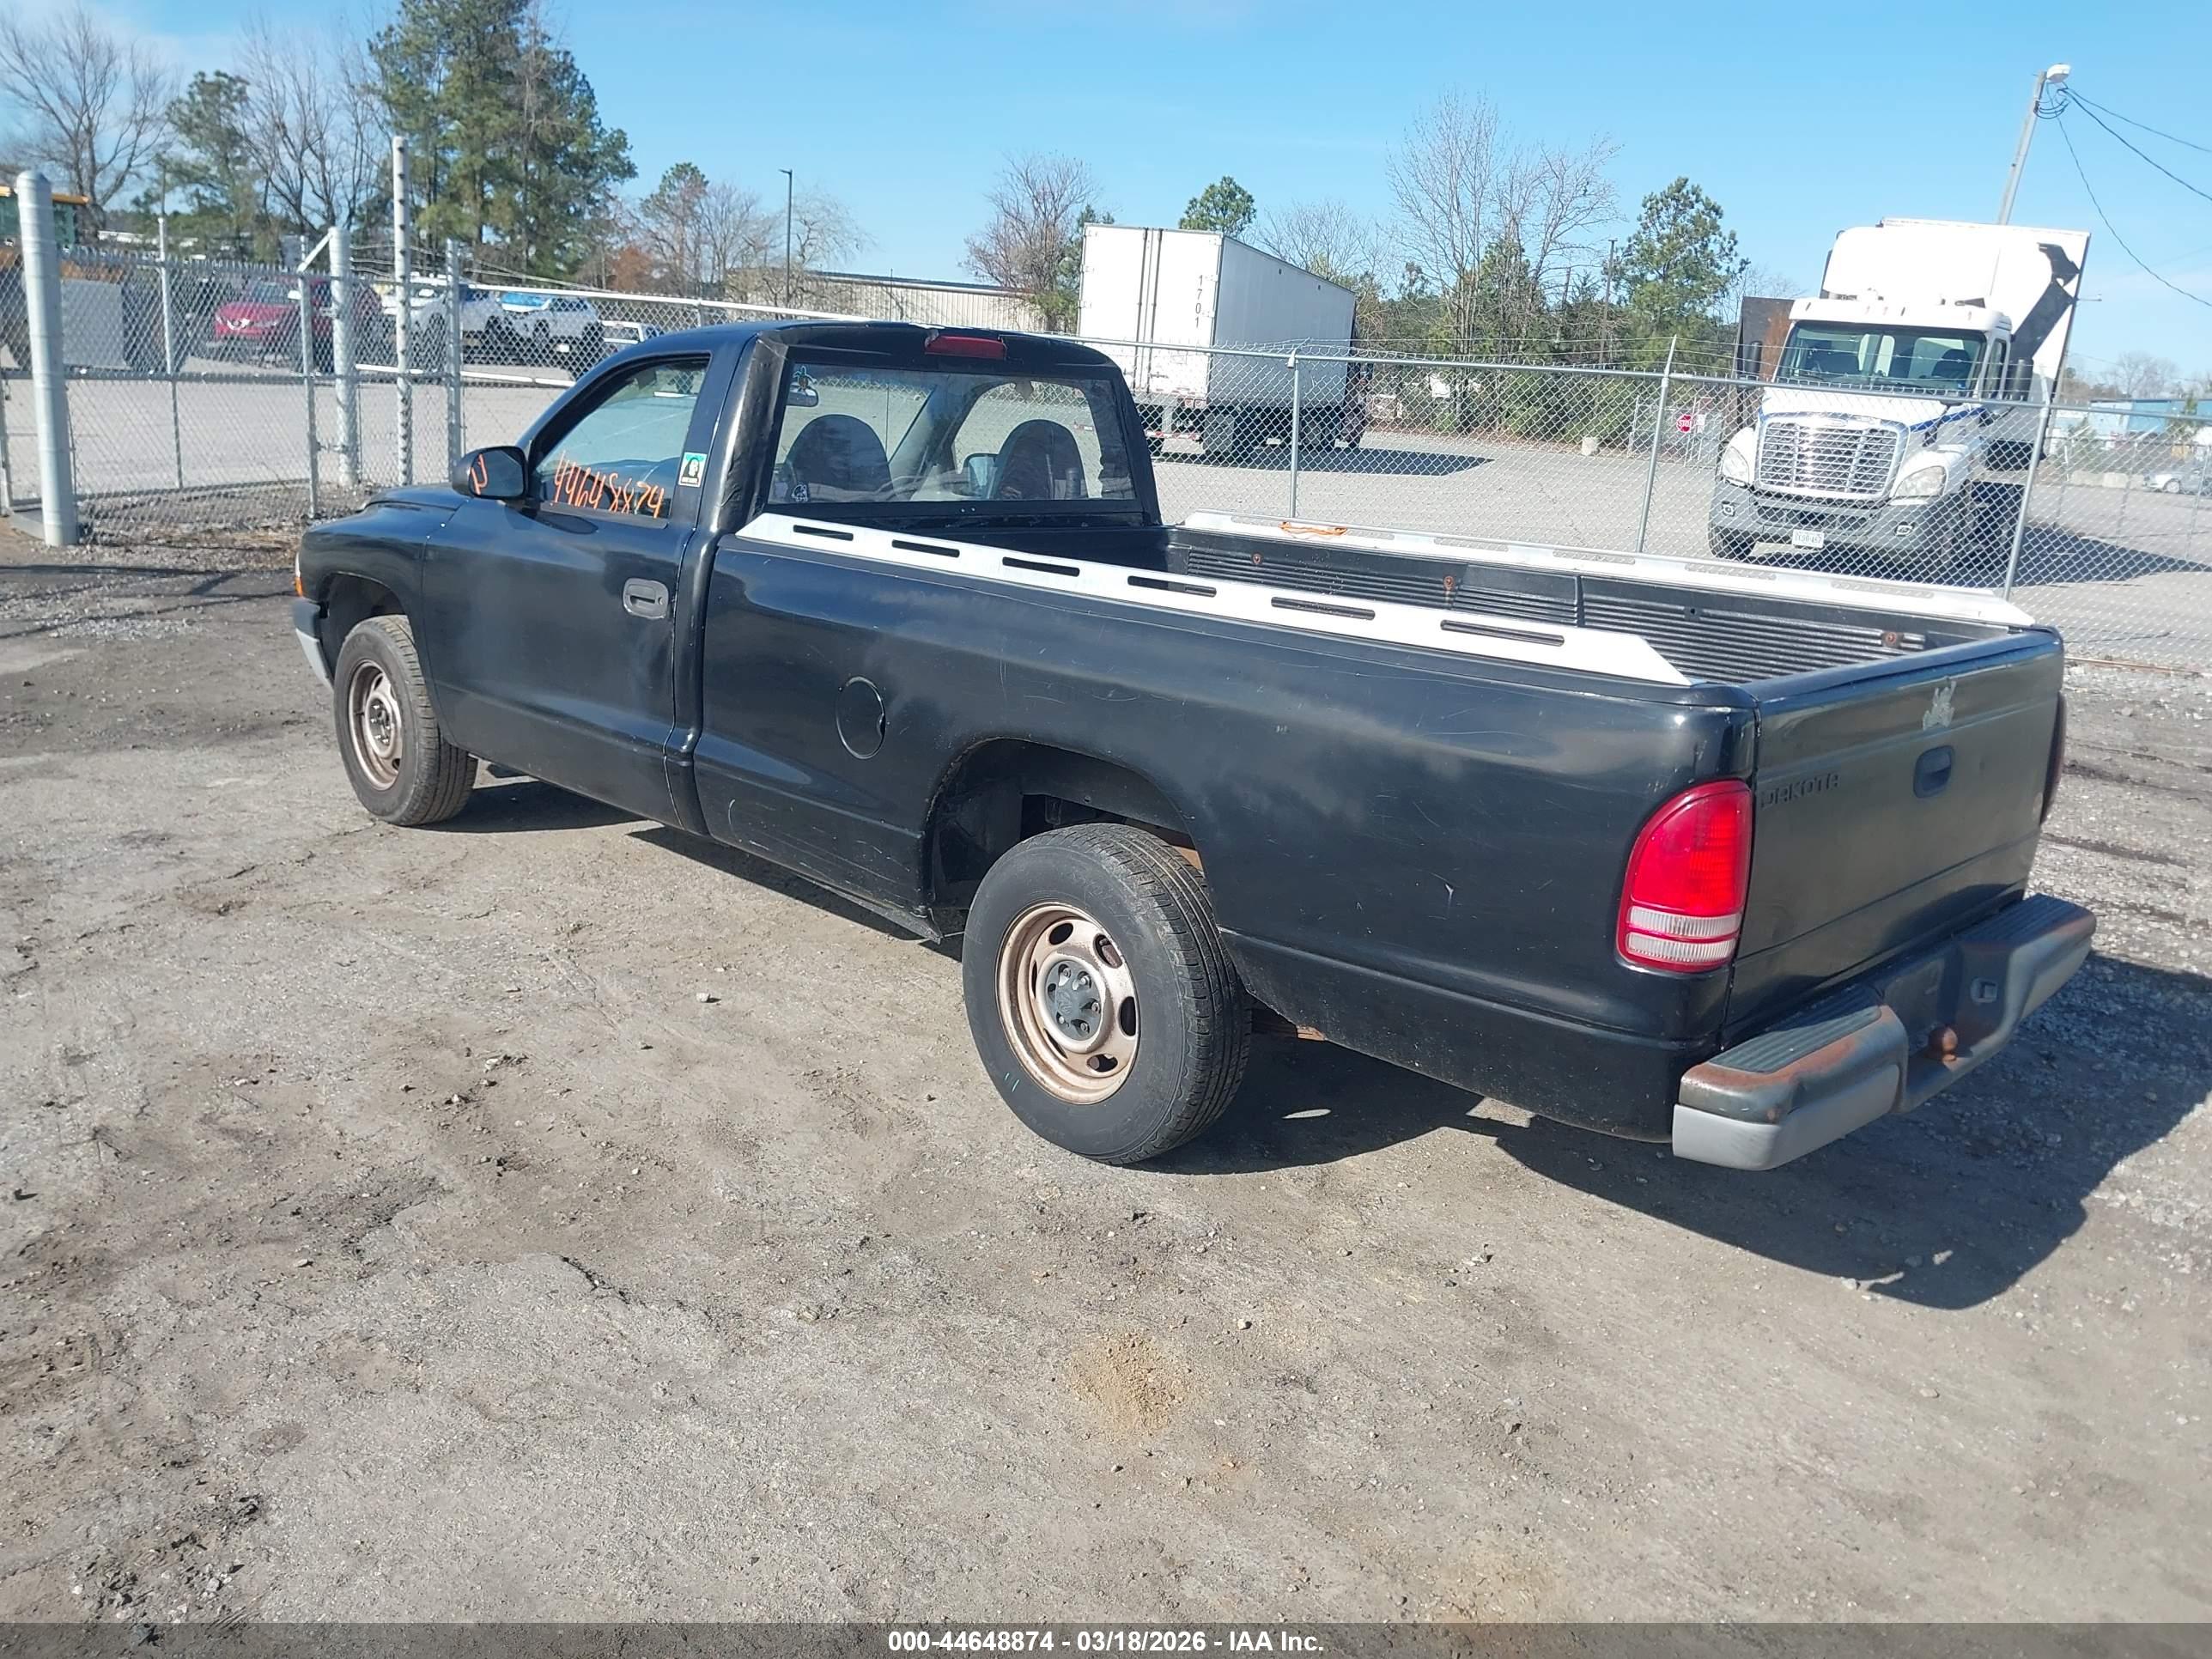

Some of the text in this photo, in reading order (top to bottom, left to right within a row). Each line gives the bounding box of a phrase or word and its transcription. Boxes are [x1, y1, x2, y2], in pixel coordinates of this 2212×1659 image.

[1194, 274, 1203, 328] 1701
[554, 450, 665, 519] 44648874
[1760, 772, 1840, 809] DAKOTA
